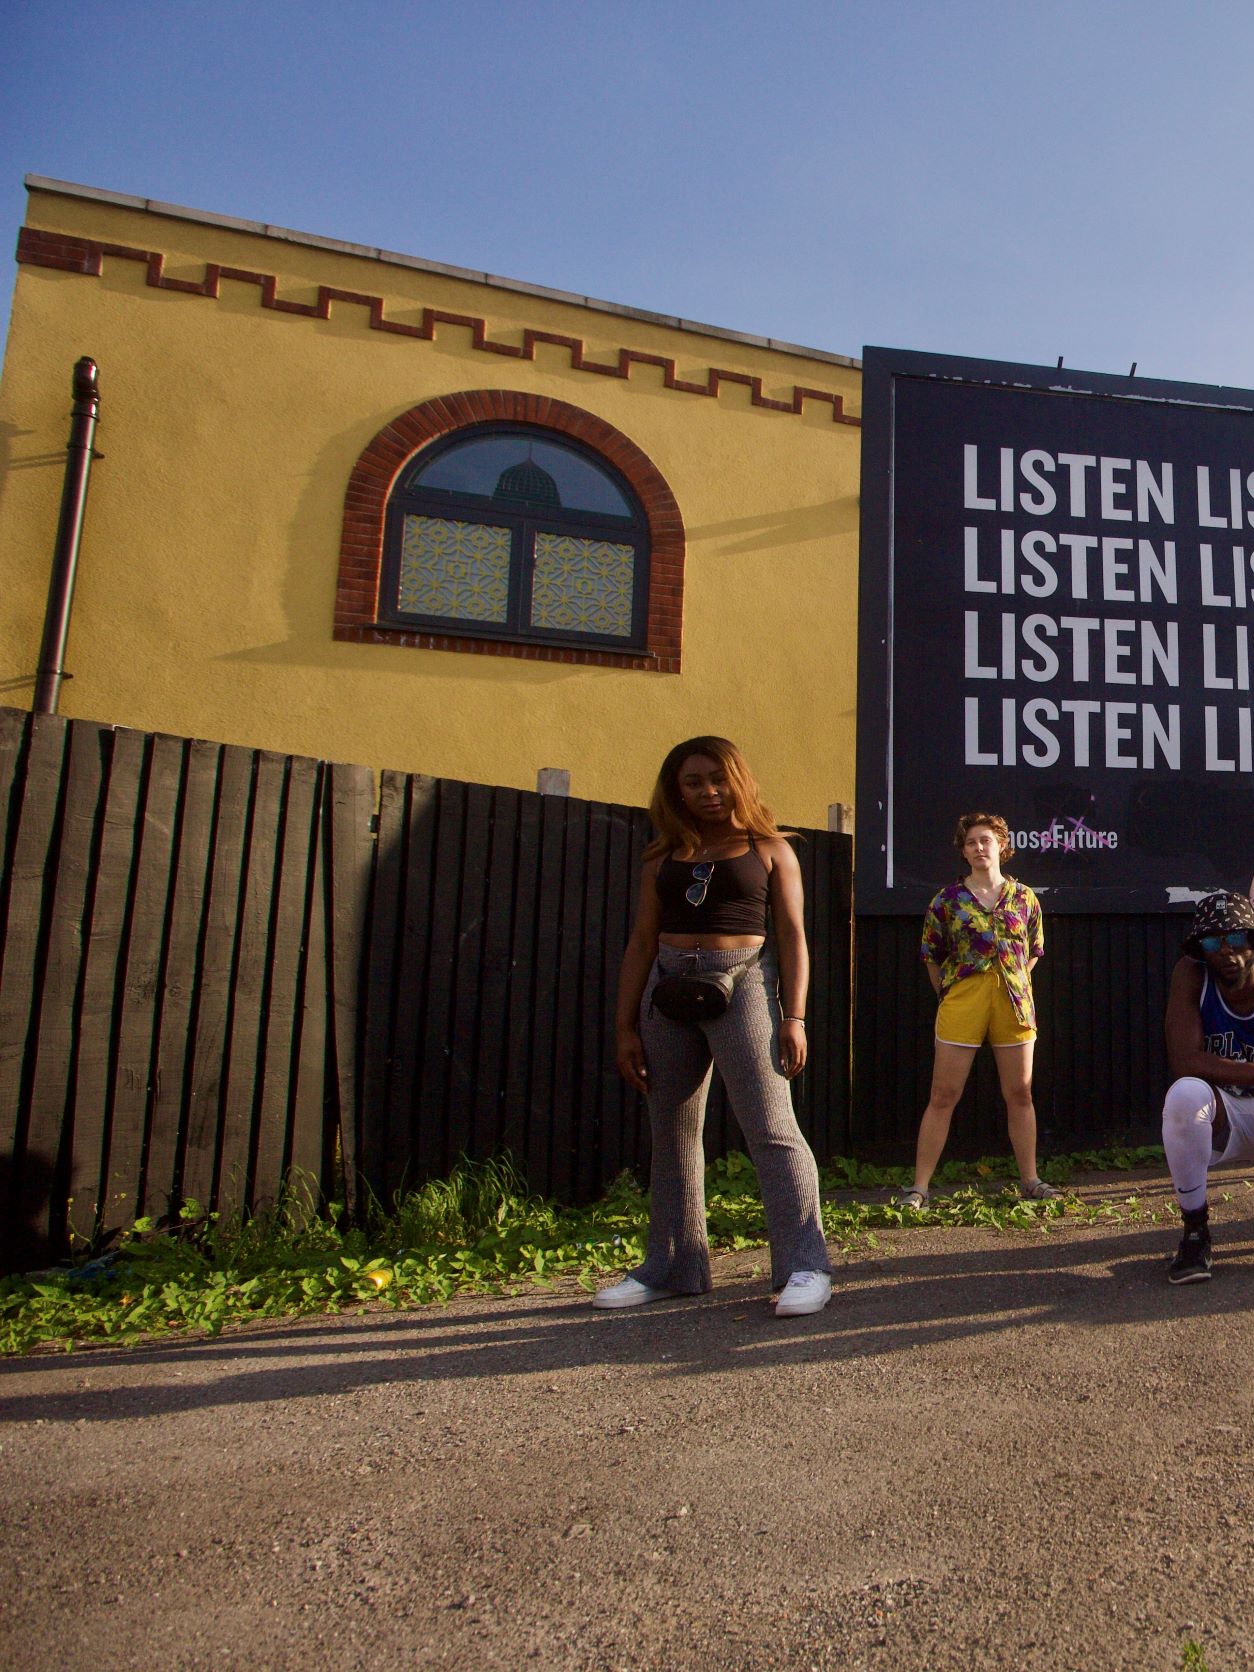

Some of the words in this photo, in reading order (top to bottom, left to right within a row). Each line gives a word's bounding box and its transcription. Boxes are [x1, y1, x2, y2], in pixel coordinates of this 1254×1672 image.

[965, 445, 1174, 524] LISTEN
[965, 527, 1177, 603] LISTEN
[965, 611, 1179, 686] LISTEN
[965, 697, 1180, 769] LISTEN
